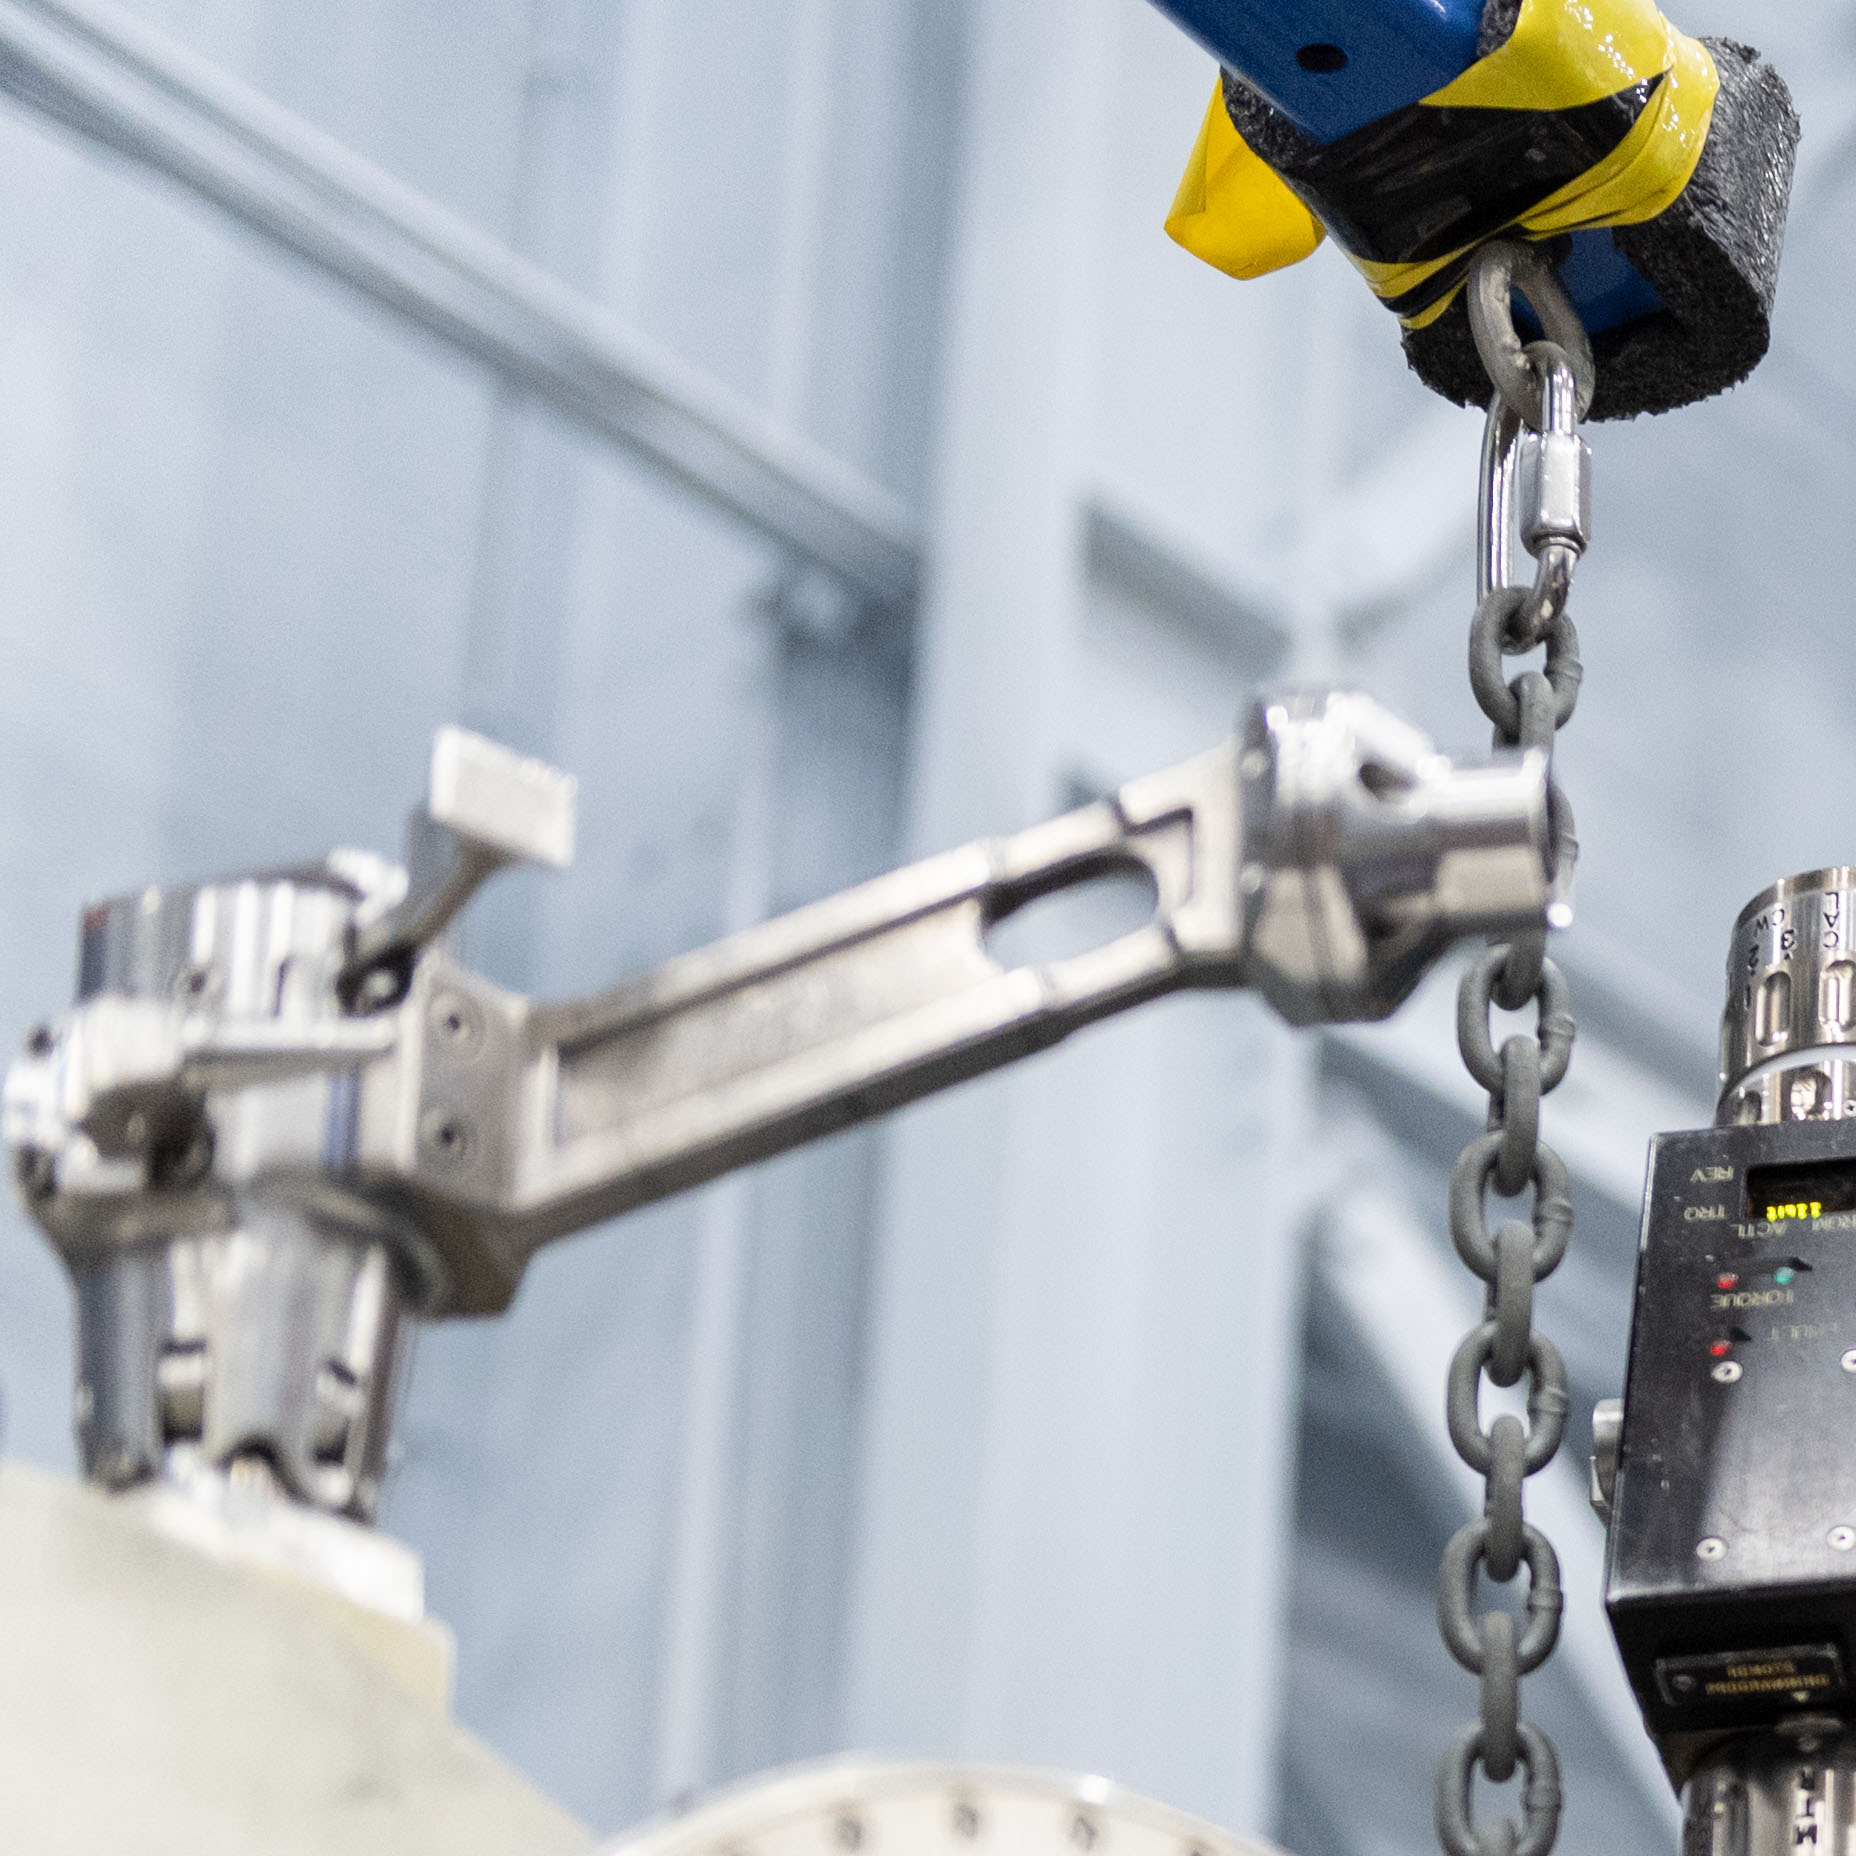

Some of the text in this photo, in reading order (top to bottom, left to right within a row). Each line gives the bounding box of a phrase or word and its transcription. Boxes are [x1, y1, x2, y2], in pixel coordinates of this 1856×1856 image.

[1755, 908, 1786, 931] CW
[1823, 891, 1840, 950] CAL
[1780, 928, 1796, 950] 3
[1690, 1166, 1734, 1183] REV
[1710, 1289, 1794, 1311] TORQUE
